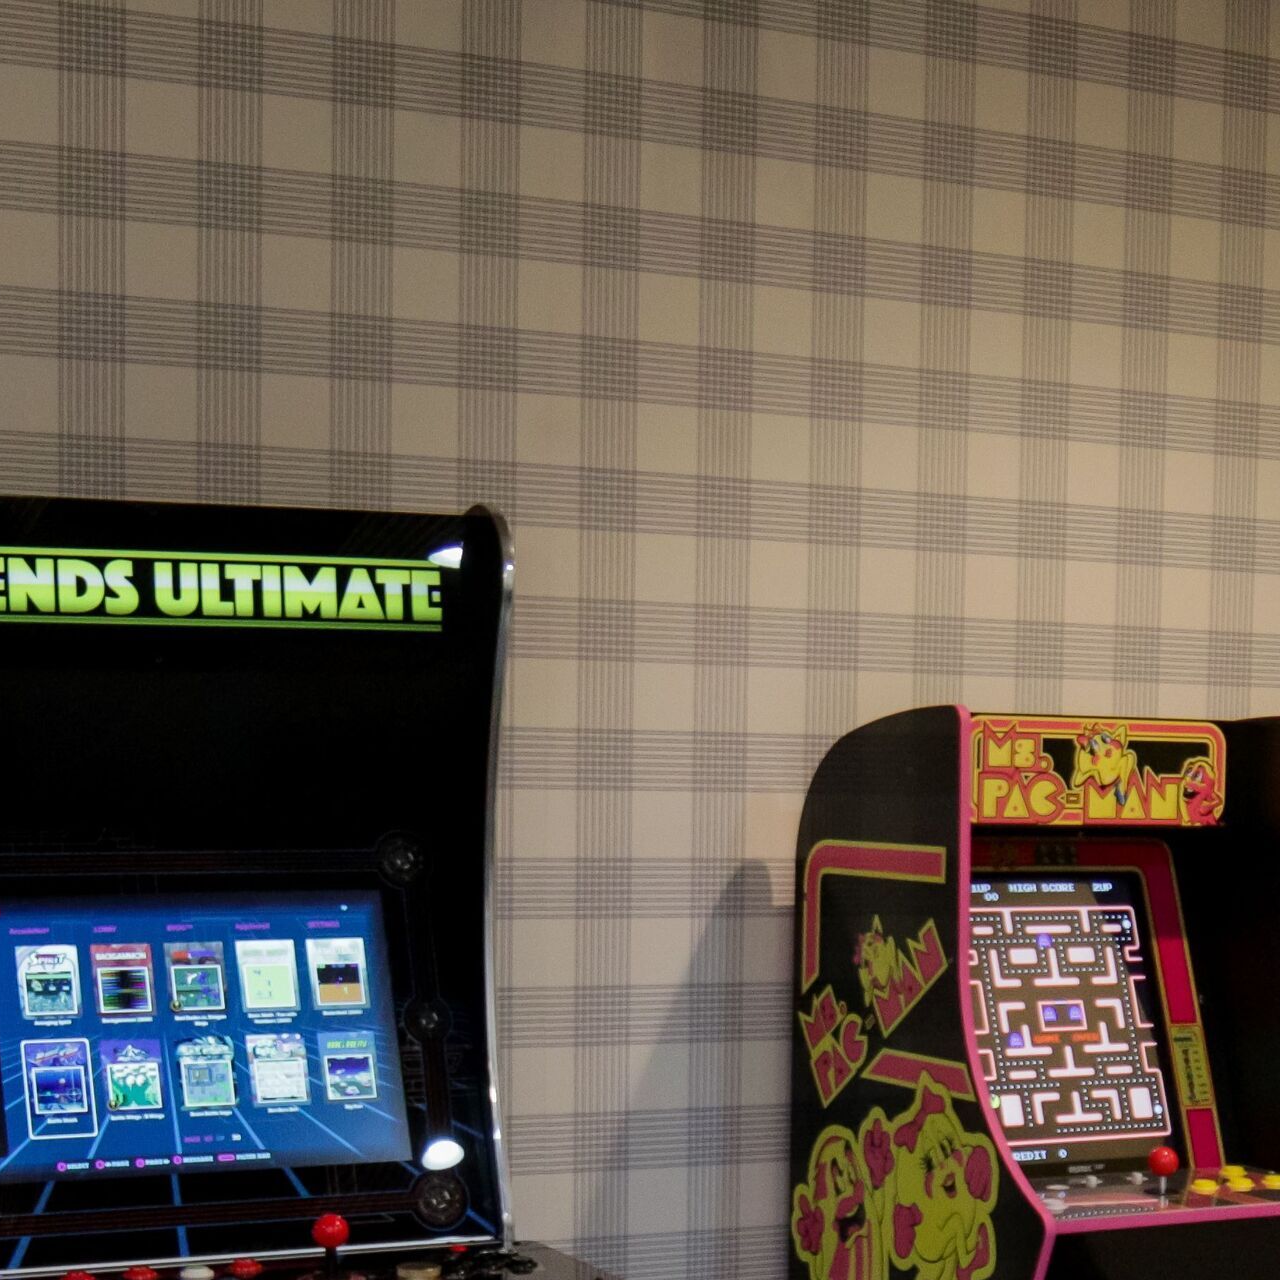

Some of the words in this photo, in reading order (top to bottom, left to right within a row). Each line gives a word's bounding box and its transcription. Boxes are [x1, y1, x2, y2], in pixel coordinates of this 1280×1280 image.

[154, 560, 443, 622] ULTIMATE
[985, 727, 1051, 770] Ms.
[980, 770, 1180, 821] PAC-MAN
[1008, 884, 1037, 893] HIGH
[1041, 883, 1076, 892] SCORE
[1092, 883, 1113, 892] 2UP
[1011, 1150, 1047, 1162] REDIT
